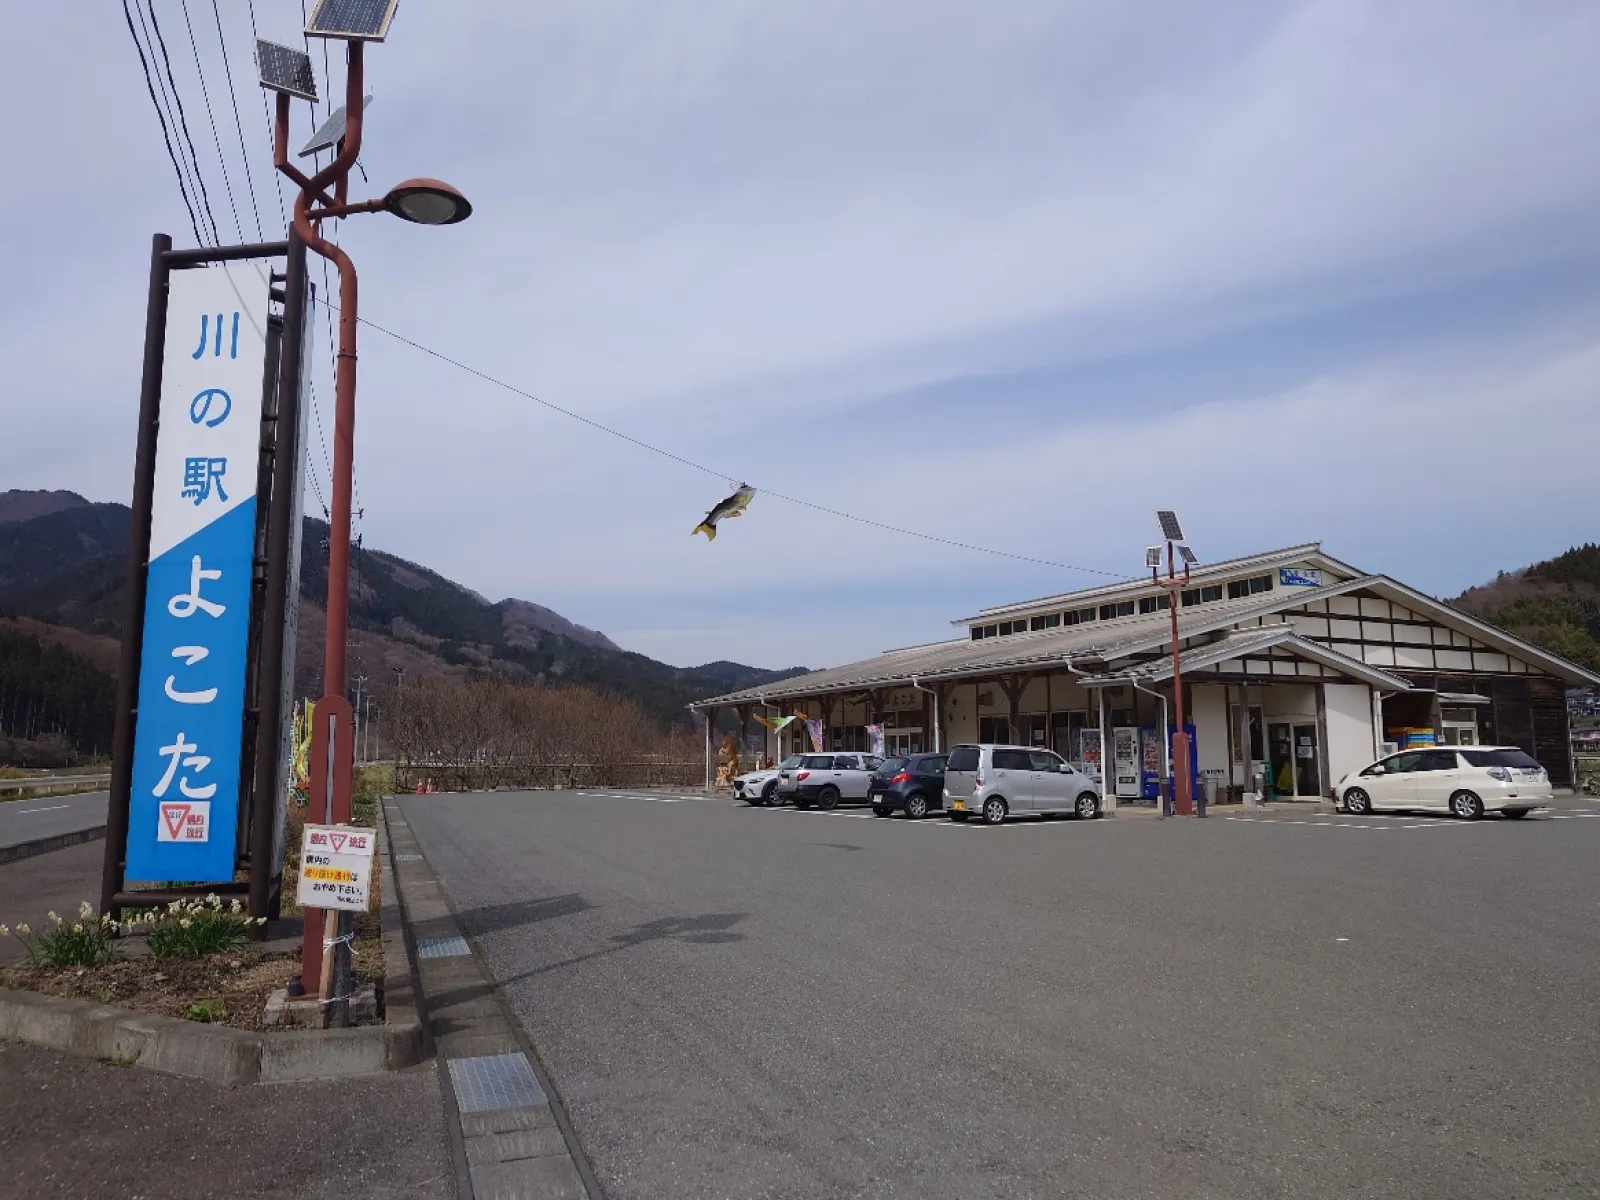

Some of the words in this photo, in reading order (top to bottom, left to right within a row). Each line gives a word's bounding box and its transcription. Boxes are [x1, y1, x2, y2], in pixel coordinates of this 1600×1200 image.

[181, 311, 240, 506] 川の駅
[151, 554, 226, 799] よこた
